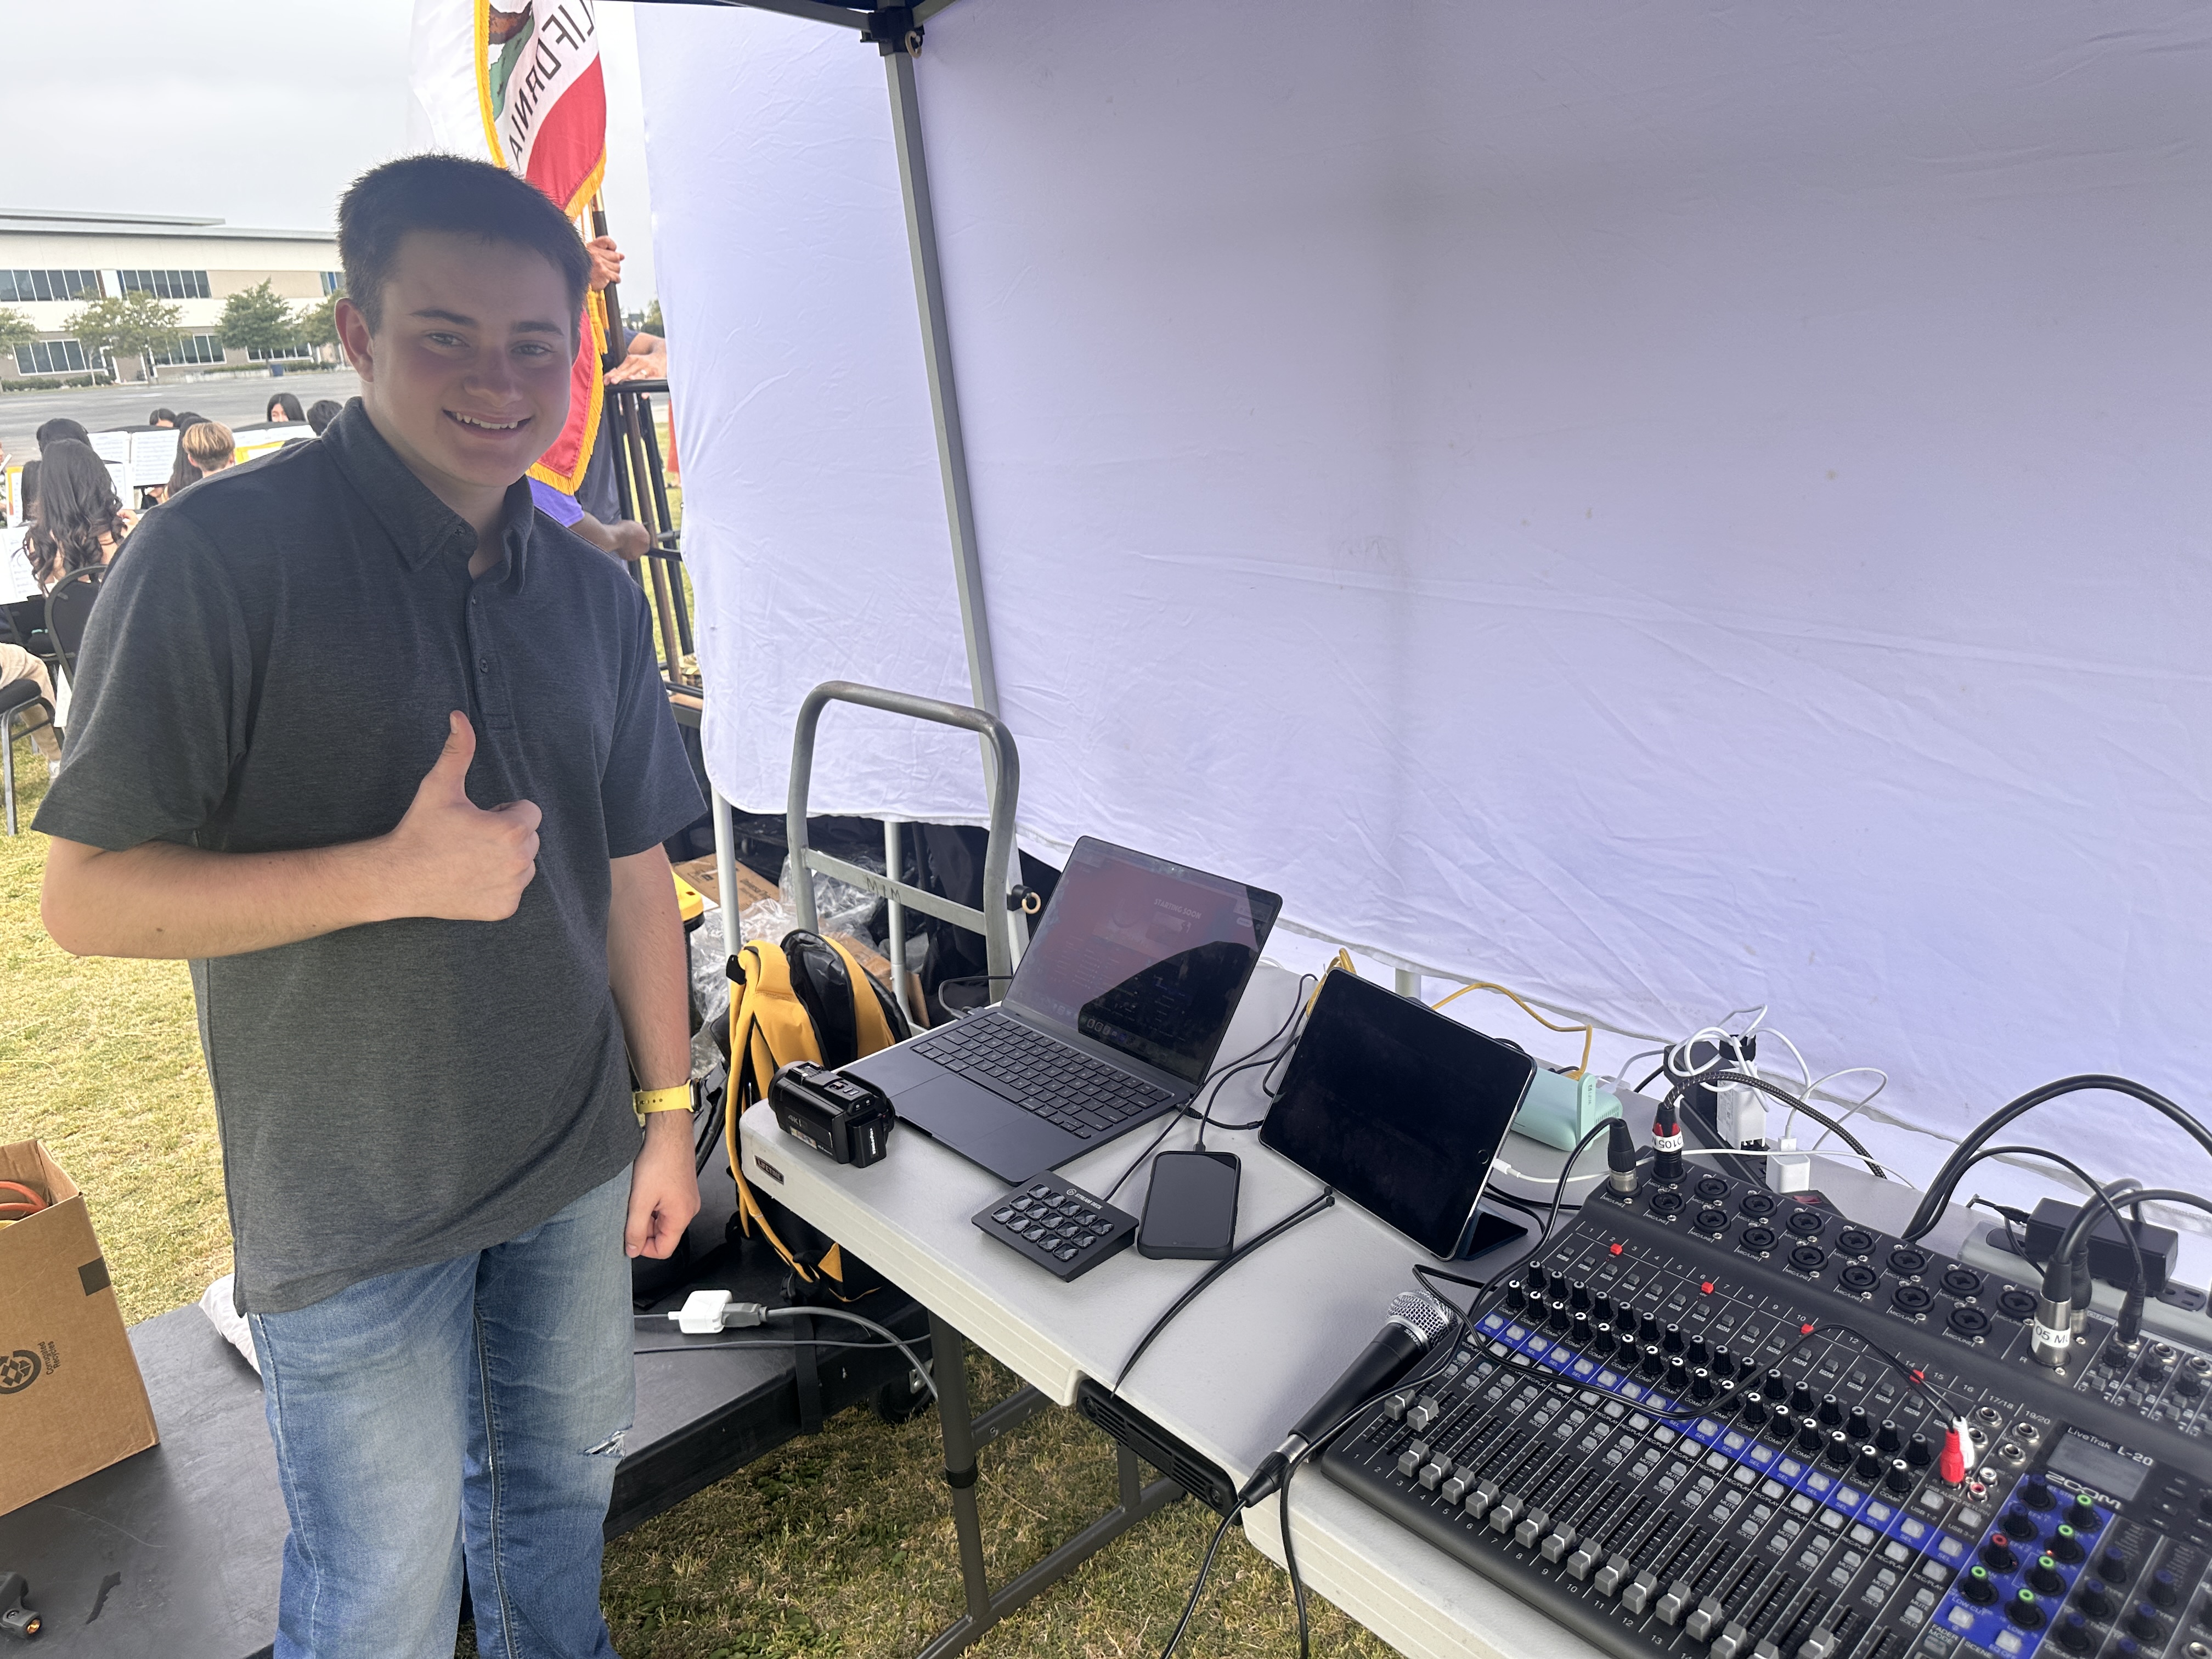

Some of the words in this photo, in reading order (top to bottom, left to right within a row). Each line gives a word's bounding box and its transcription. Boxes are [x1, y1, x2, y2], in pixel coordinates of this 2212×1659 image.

[1154, 899, 1183, 913] STARTING
[1182, 908, 1203, 919] SOON
[757, 1158, 782, 1181] LIFETIME
[1075, 1193, 1093, 1204] STREAM
[1090, 1201, 1103, 1210] DECK
[1603, 1196, 1623, 1207] MIC/LINE
[1646, 1213, 1667, 1224] MIC/LINE
[1690, 1231, 1712, 1242] MIC/LINE
[1737, 1249, 1759, 1261] MIC/LINE
[1785, 1268, 1809, 1280] MIC/LINE
[1836, 1289, 1860, 1301] MIC/LINE
[1499, 1306, 1514, 1316] COMP
[1889, 1310, 1916, 1323] MIC/LINE
[2087, 1311, 2106, 1322] OUT
[1521, 1317, 1536, 1326] COMP
[1995, 1313, 2023, 1327] MIC/LINE
[1543, 1328, 1558, 1338] COMP
[1565, 1339, 1581, 1348] COMP
[1945, 1332, 1972, 1346] MIC/LINE
[48, 1341, 61, 1369] Recycles
[1588, 1350, 1604, 1359] COMP
[1767, 1346, 1781, 1354] PAD
[38, 1341, 54, 1375] Corrugated
[2019, 1356, 2027, 1364] R
[1611, 1361, 1628, 1371] COMP
[1526, 1374, 1547, 1387] REC/PLAY
[1635, 1373, 1652, 1383] COMP
[1659, 1385, 1677, 1395] COMP
[1848, 1382, 1861, 1390] PAD
[1963, 1384, 1974, 1392] 16
[1548, 1386, 1570, 1400] REC/PLAY
[1685, 1397, 1702, 1407] COMP
[1876, 1395, 1890, 1403] PAD
[1989, 1395, 2014, 1409] 17/18
[1541, 1406, 1555, 1415] MUTE
[1571, 1399, 1594, 1412] REC/PLAY
[1905, 1407, 1919, 1415] PAD
[1565, 1418, 1579, 1427] MUTE
[1595, 1411, 1618, 1424] REC/PLAY
[2025, 1410, 2051, 1424] 19/20
[1528, 1419, 1542, 1428] SOLO
[1736, 1422, 1755, 1432] COMP
[1589, 1430, 1604, 1440] MUTE
[1620, 1423, 1644, 1437] REC/PLAY
[1552, 1431, 1566, 1441] SOLO
[1695, 1432, 1705, 1441] SEL
[1764, 1435, 1782, 1445] COMP
[1576, 1444, 1590, 1454] SOLO
[1613, 1443, 1629, 1453] MUTE
[1645, 1436, 1669, 1451] REC/PLAY
[2067, 1426, 2112, 1449] LiveTrak
[2117, 1446, 2154, 1466] L-20
[1721, 1446, 1732, 1454] SEL
[1792, 1448, 1811, 1459] COMP
[1671, 1449, 1696, 1463] REC/PLAY
[1601, 1458, 1616, 1467] SOLO
[1639, 1457, 1654, 1467] MUTE
[1749, 1459, 1760, 1467] SEL
[1820, 1462, 1840, 1473] COMP
[1627, 1471, 1642, 1481] SOLO
[1666, 1470, 1681, 1481] MUTE
[1697, 1463, 1723, 1478] REC/PLAY
[1777, 1472, 1788, 1481] SEL
[1849, 1476, 1870, 1488] COMP
[1724, 1476, 1751, 1492] REC/PLAY
[1653, 1485, 1668, 1495] SOLO
[1692, 1485, 1708, 1495] MUTE
[1806, 1487, 1818, 1496] SEL
[2045, 1471, 2121, 1509] ZOOM
[1753, 1491, 1779, 1507] REC/PLAY
[1879, 1491, 1900, 1502] COMP
[1925, 1483, 1939, 1493] USB
[1940, 1491, 1962, 1503] AUDIO
[1962, 1500, 1990, 1516] RETURN
[1680, 1499, 1696, 1510] SOLO
[1719, 1499, 1736, 1509] MUTE
[1835, 1502, 1847, 1511] SEL
[1781, 1505, 1809, 1522] REC/PLAY
[1910, 1505, 1925, 1515] USB
[1926, 1513, 1937, 1521] 1-2
[1707, 1514, 1724, 1525] SOLO
[1748, 1514, 1765, 1525] MUTE
[1866, 1517, 1878, 1526] SEL
[1810, 1520, 1838, 1536] REC/PLAY
[1948, 1523, 1962, 1533] USB
[1963, 1530, 1975, 1539] 3-4
[1736, 1529, 1752, 1540] SOLO
[1777, 1529, 1795, 1540] MUTE
[1900, 1534, 1912, 1543] SEL
[1765, 1544, 1782, 1556] SOLO
[1807, 1545, 1825, 1556] MUTE
[1841, 1537, 1870, 1553] REC/PLAY
[1875, 1553, 1905, 1571] REC/PLAY
[1938, 1553, 1951, 1562] SEL
[1795, 1561, 1812, 1572] SOLO
[1838, 1560, 1856, 1572] MUTE
[1826, 1577, 1844, 1589] SOLO
[1872, 1579, 1891, 1591] MUTE
[1912, 1572, 1944, 1590] REC/PLAY
[1567, 1583, 1578, 1593] 10
[1594, 1600, 1605, 1609] 11
[1860, 1596, 1879, 1608] SOLO
[1910, 1599, 1930, 1611] MUTE
[1952, 1596, 1970, 1608] LOW
[1622, 1617, 1633, 1627] 12
[1899, 1616, 1918, 1628] SOLO
[1932, 1623, 1959, 1641] FADER
[2007, 1624, 2025, 1636] LOW
[1651, 1635, 1663, 1645] 13
[1928, 1629, 1954, 1645] MODE
[1964, 1641, 1993, 1658] SCENE
